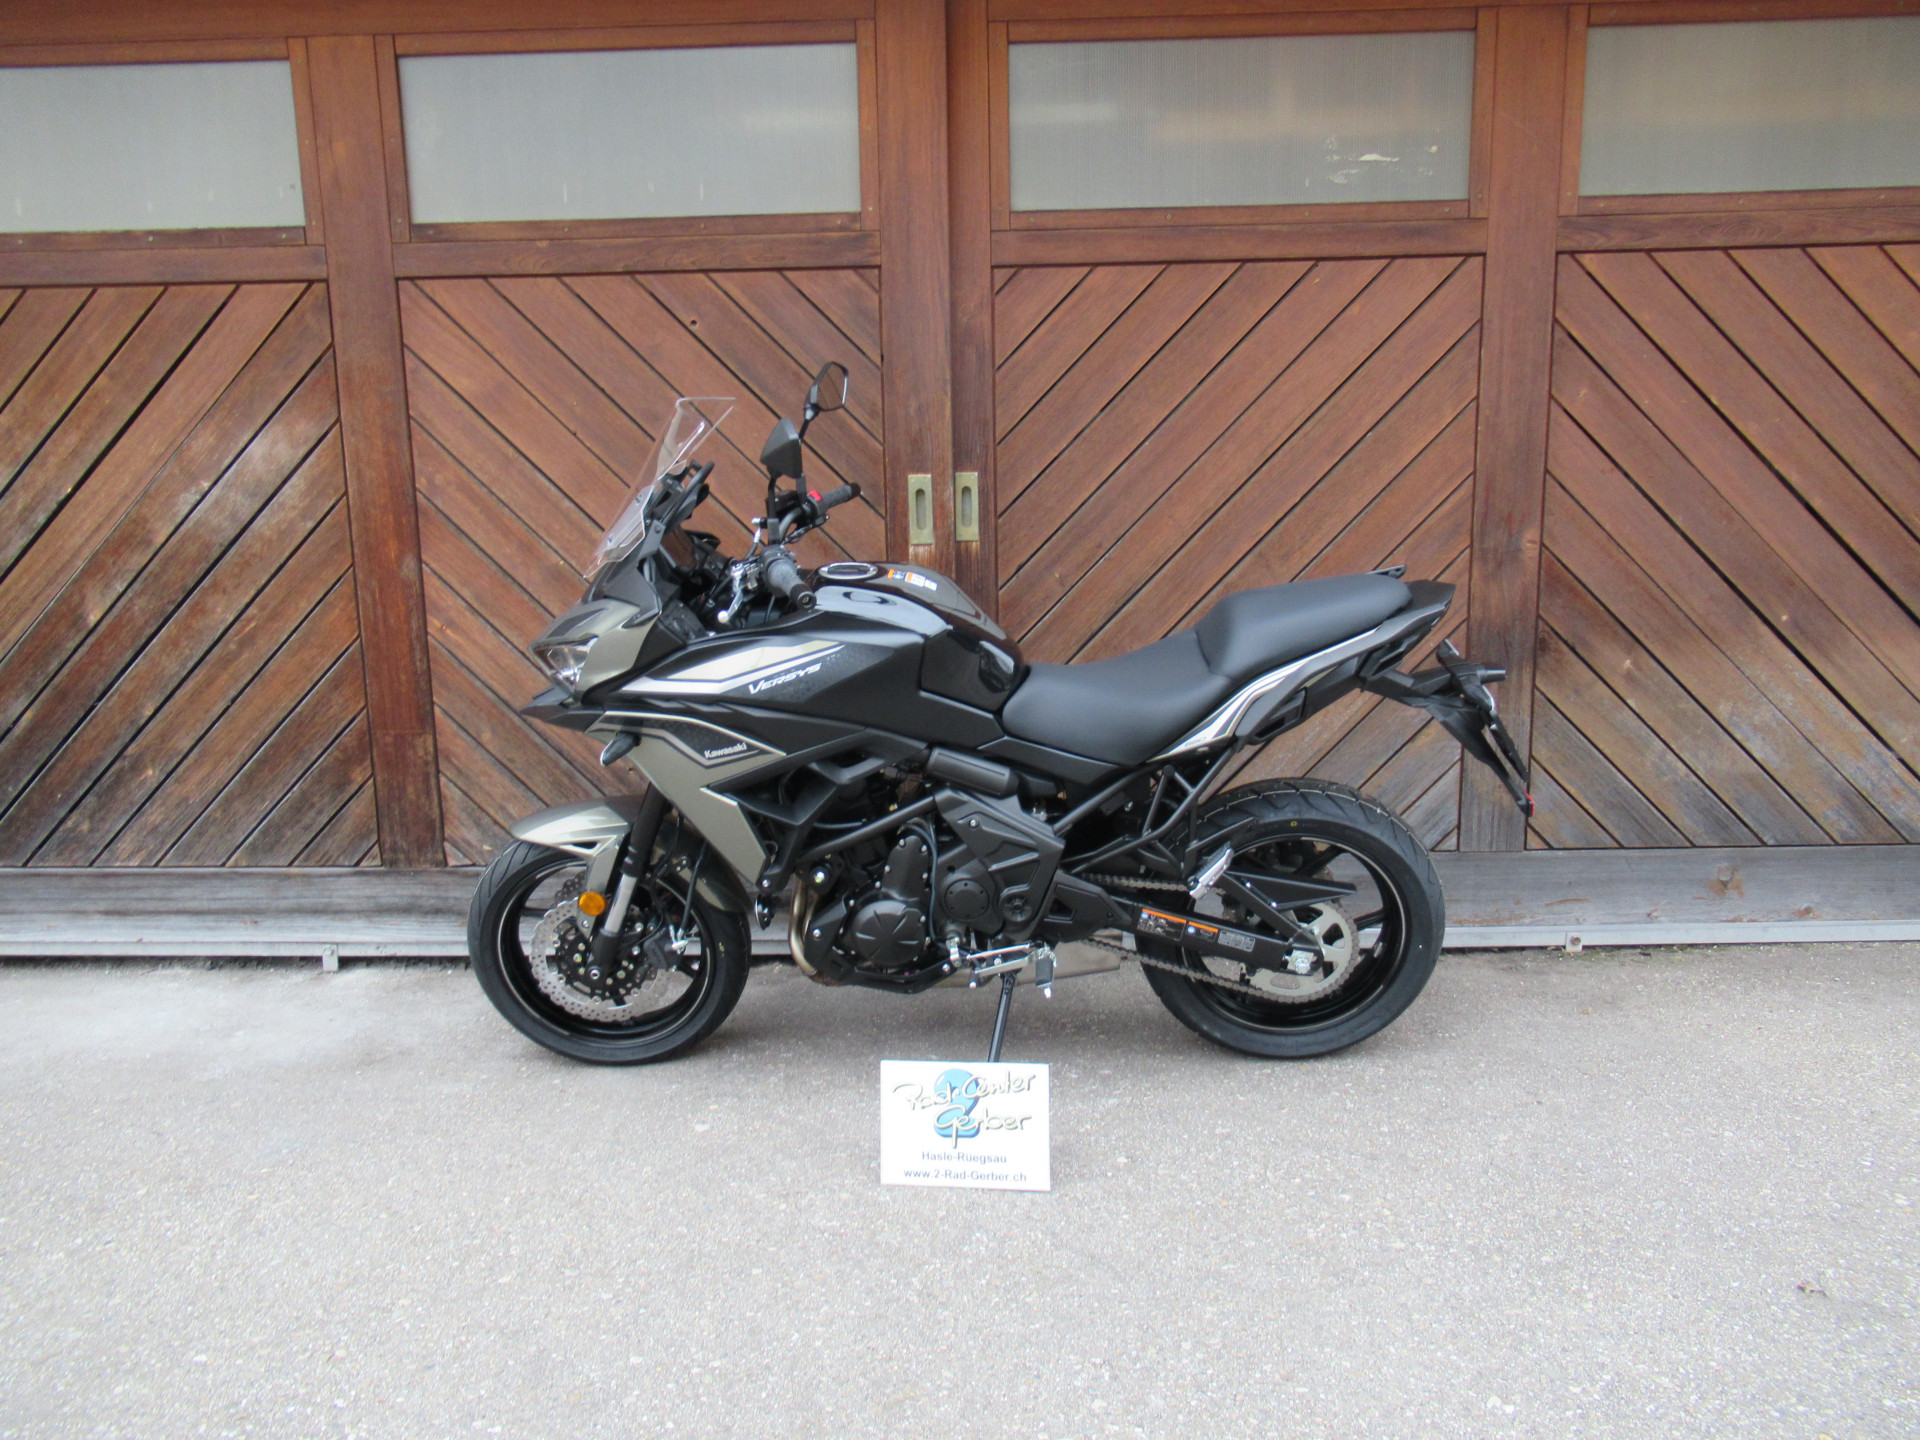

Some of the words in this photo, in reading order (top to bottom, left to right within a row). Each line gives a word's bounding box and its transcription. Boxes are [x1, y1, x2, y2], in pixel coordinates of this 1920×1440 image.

[704, 742, 747, 758] Kawasaki
[961, 1070, 1036, 1099] Center
[935, 1104, 1032, 1149] Gerber
[921, 1151, 1007, 1165] Hasle-Rüegsau
[904, 1168, 1027, 1183] www.2-Rad-Gerber.ch
